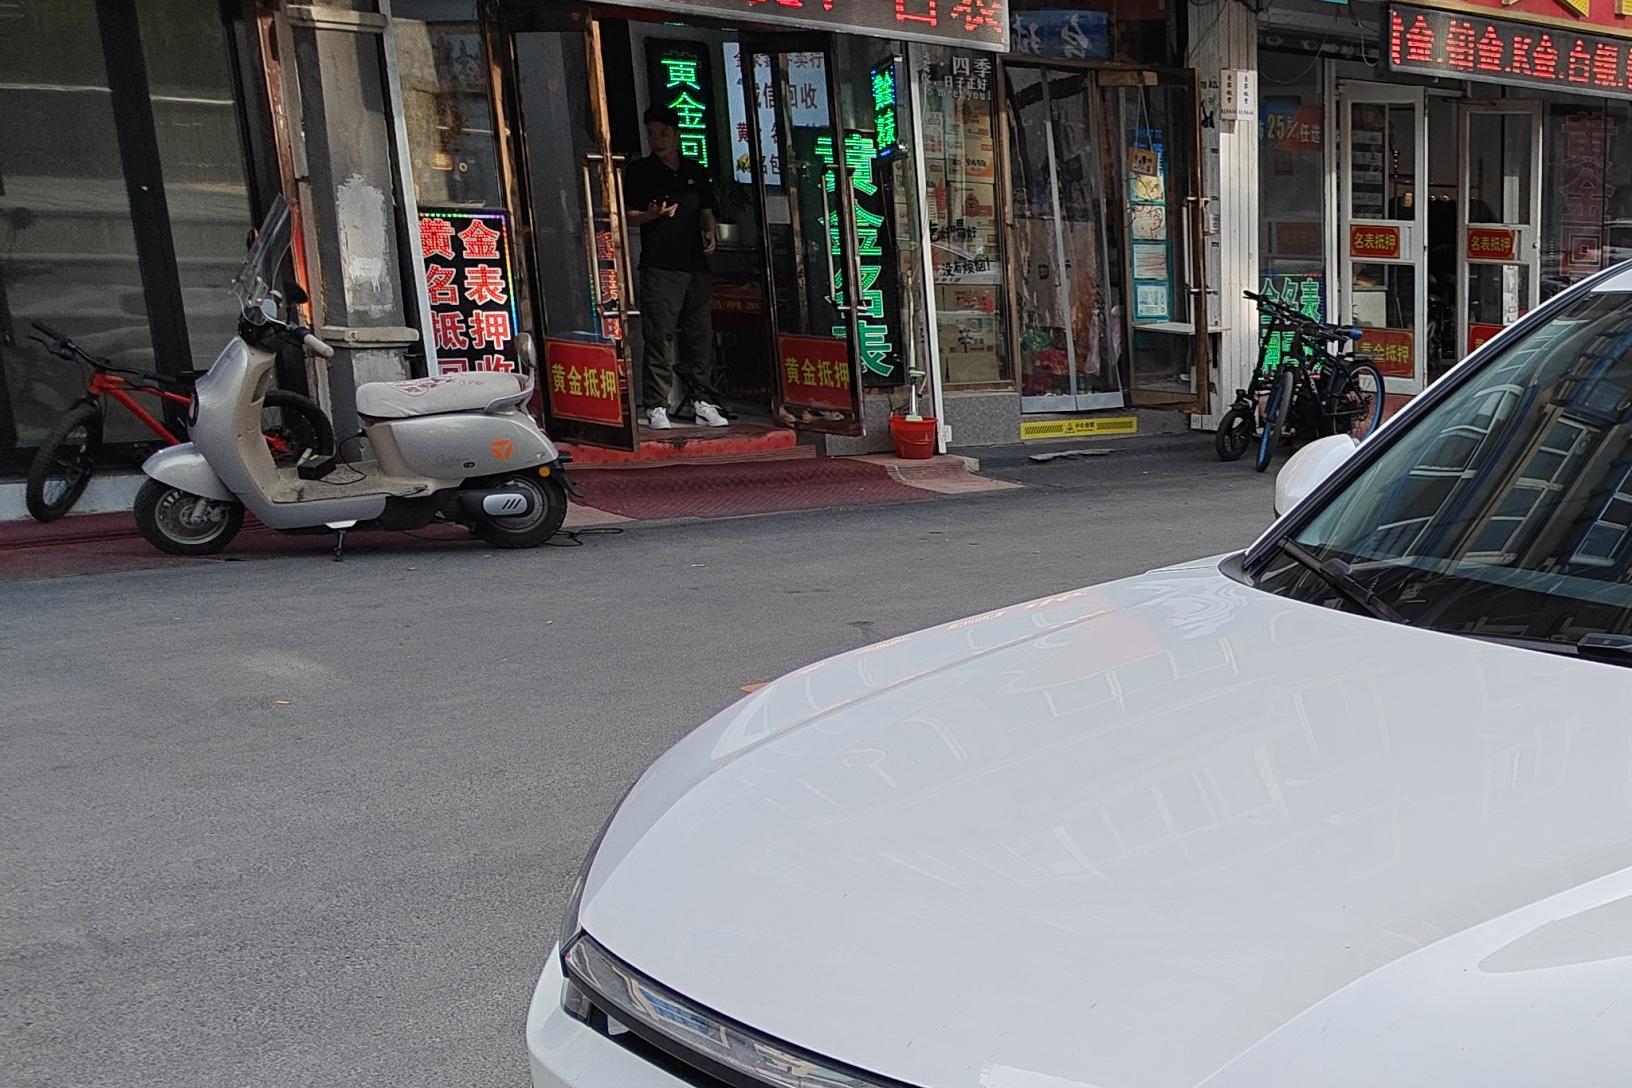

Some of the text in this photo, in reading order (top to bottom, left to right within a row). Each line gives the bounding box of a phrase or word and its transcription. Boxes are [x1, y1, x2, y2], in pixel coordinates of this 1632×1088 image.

[417, 217, 501, 261] 黄金
[1353, 232, 1397, 251] 名表抵押
[1470, 235, 1512, 252] 名表抵押
[425, 264, 508, 306] 名表
[431, 309, 511, 351] 抵押
[551, 362, 618, 401] 黄金抵押
[784, 356, 850, 389] 黄金抵押
